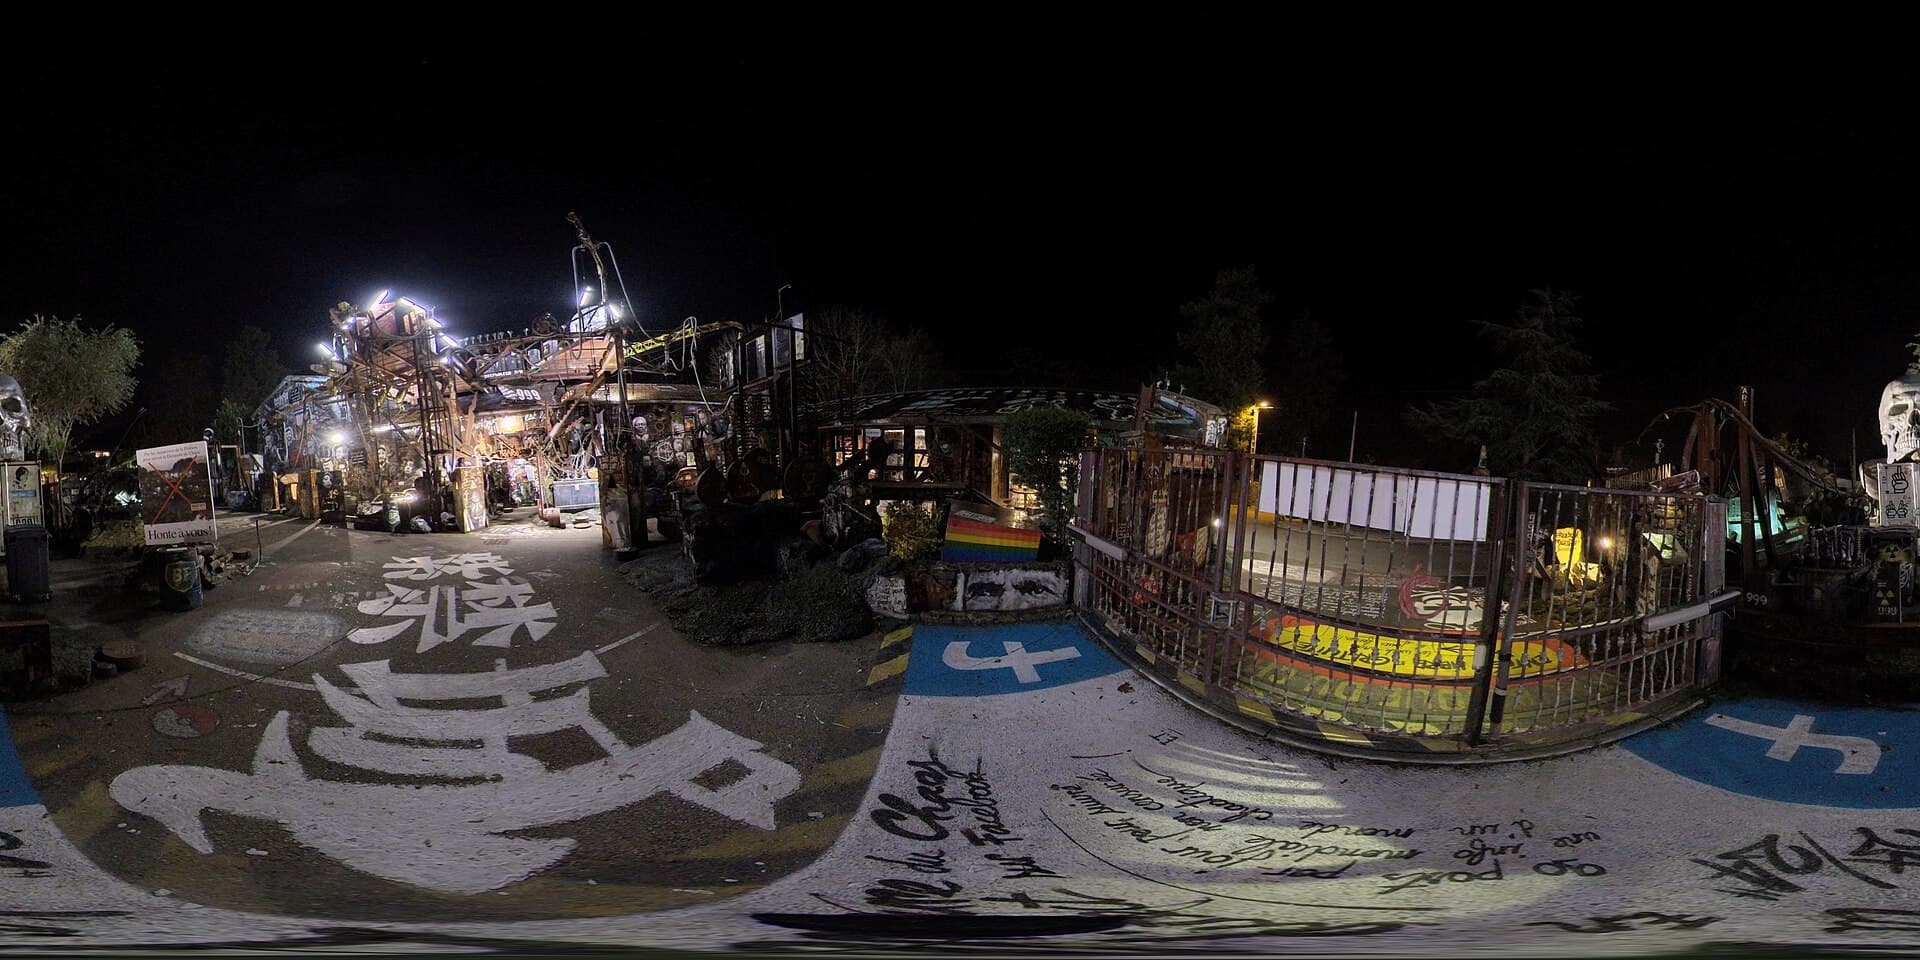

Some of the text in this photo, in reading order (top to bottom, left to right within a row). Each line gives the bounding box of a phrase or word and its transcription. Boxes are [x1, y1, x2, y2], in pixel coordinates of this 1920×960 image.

[516, 389, 542, 401] 999
[148, 529, 178, 540] Honte
[1745, 591, 1768, 607] 999
[864, 745, 952, 842] Chaos
[952, 756, 1024, 847] Facebook
[1171, 814, 1224, 834] non
[1291, 817, 1416, 838] monde
[1448, 817, 1534, 846] d'un
[1240, 832, 1425, 867] mondiale
[1550, 830, 1601, 848] une
[1162, 834, 1275, 878] jour
[1452, 836, 1527, 866] info
[1258, 865, 1356, 883] par
